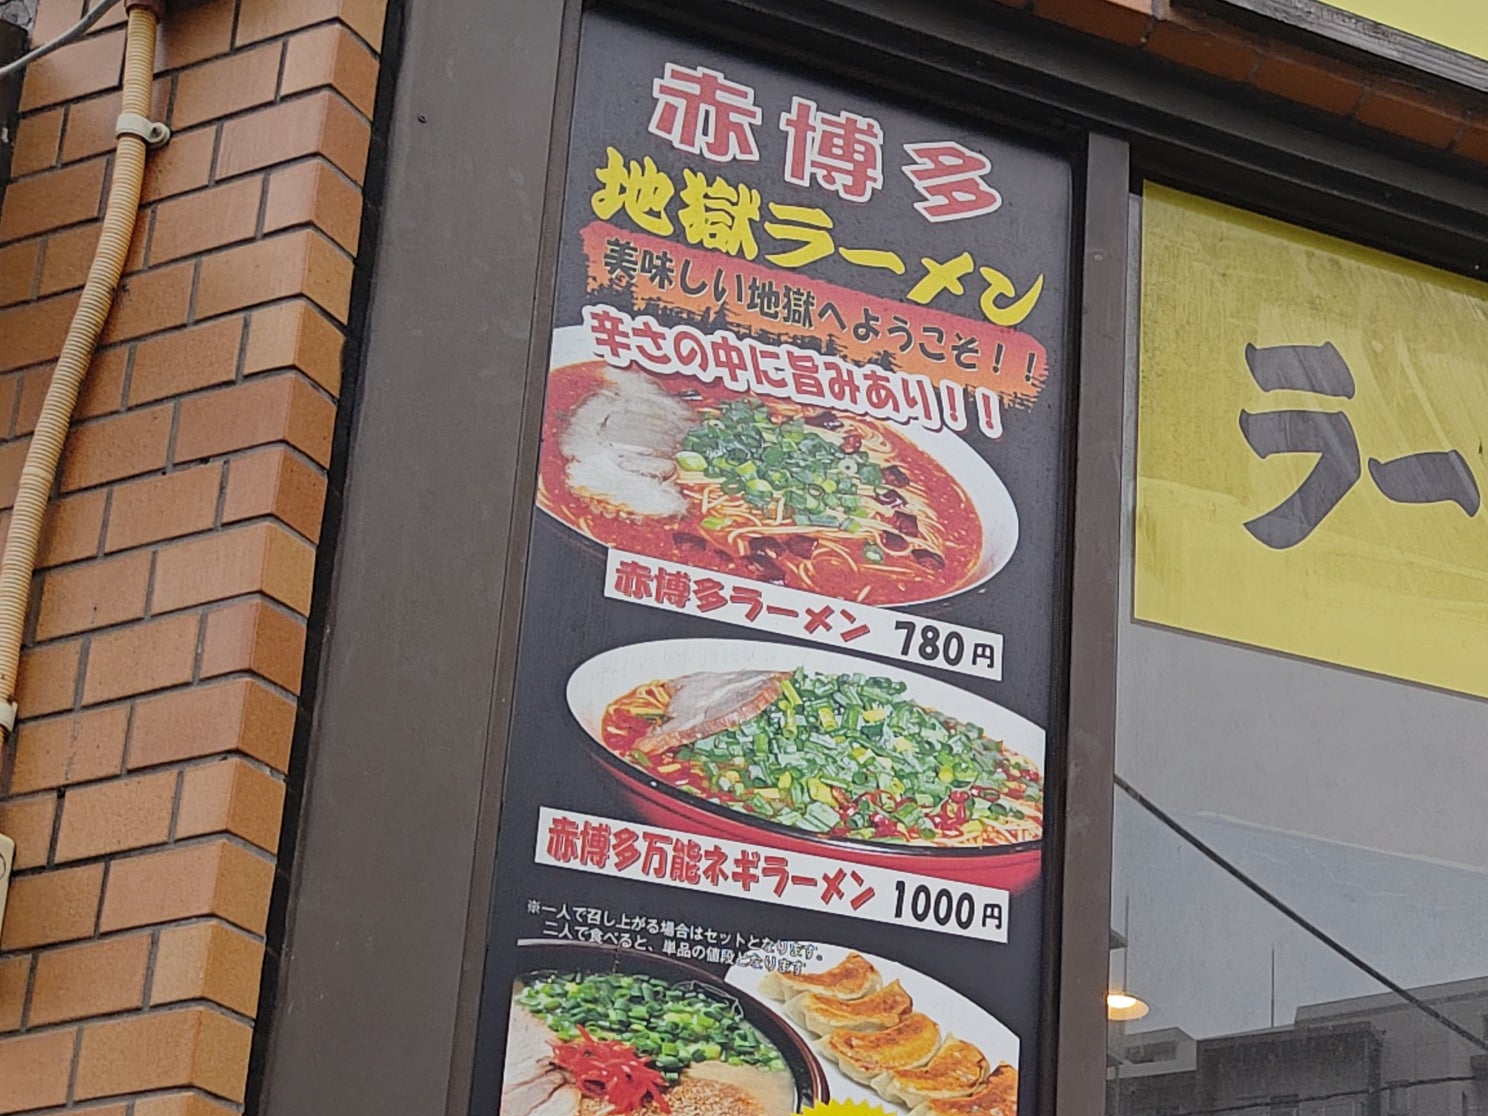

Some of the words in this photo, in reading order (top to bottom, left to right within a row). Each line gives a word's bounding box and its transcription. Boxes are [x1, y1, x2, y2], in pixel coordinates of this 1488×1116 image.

[648, 62, 1002, 222] 赤博多
[591, 147, 1043, 326] 地獄ラーメン
[614, 561, 871, 643] 赤博多ラーメン
[895, 620, 997, 670] 780円
[545, 814, 877, 912] 赤博多万能ネギラーメン
[893, 880, 1004, 931] 1000円
